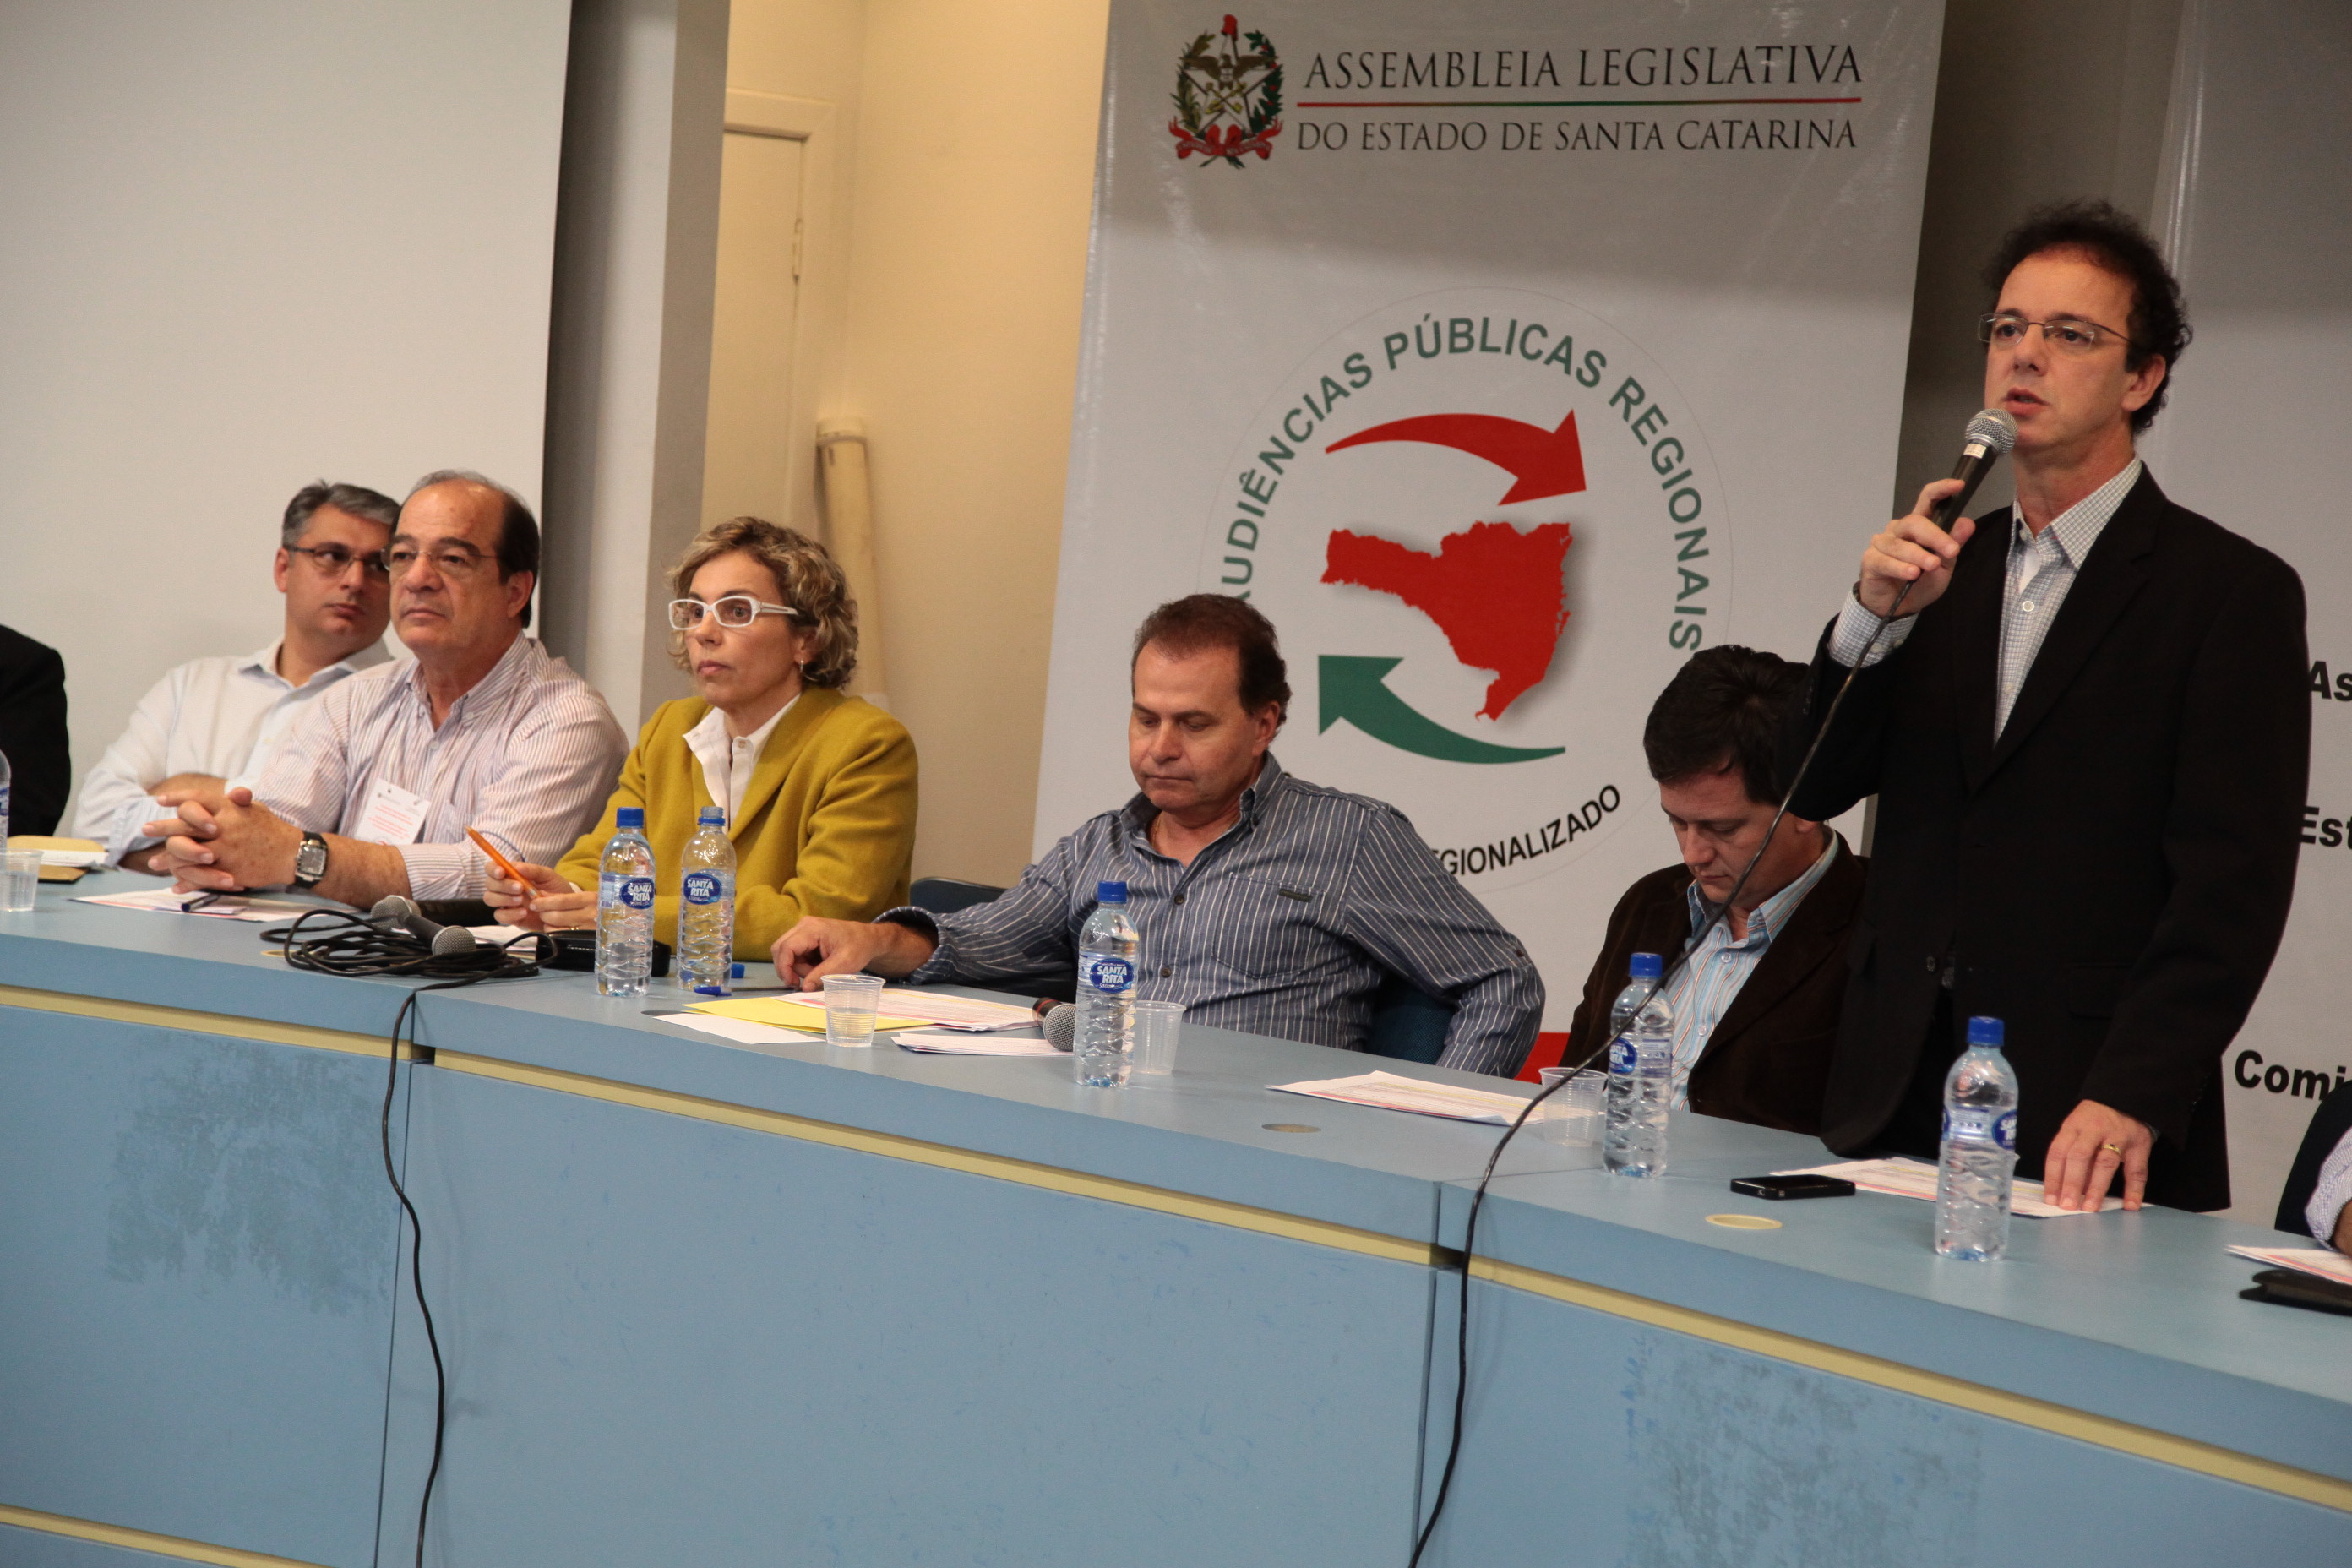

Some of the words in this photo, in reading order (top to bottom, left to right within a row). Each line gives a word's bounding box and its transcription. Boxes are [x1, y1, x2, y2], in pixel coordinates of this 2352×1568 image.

[1304, 50, 1561, 90] ASSEMBLEIA
[1577, 44, 1863, 88] LEGISLATIVA
[1298, 121, 1348, 151] DO
[1361, 121, 1488, 151] ESTADO
[1501, 121, 1544, 151] DE
[1554, 121, 1665, 151] SANTA
[1676, 118, 1858, 150] CATARINA
[1383, 313, 1607, 388] PÚBLICAS
[1609, 376, 1711, 651] REGIONAIS
[1431, 784, 1621, 876] GIONALIZADO
[627, 884, 652, 896] SANTA
[687, 879, 714, 890] SANTA
[632, 892, 651, 901] RITA
[689, 887, 710, 897] RITA
[1097, 965, 1128, 976] SANTA
[1102, 973, 1124, 984] RITA
